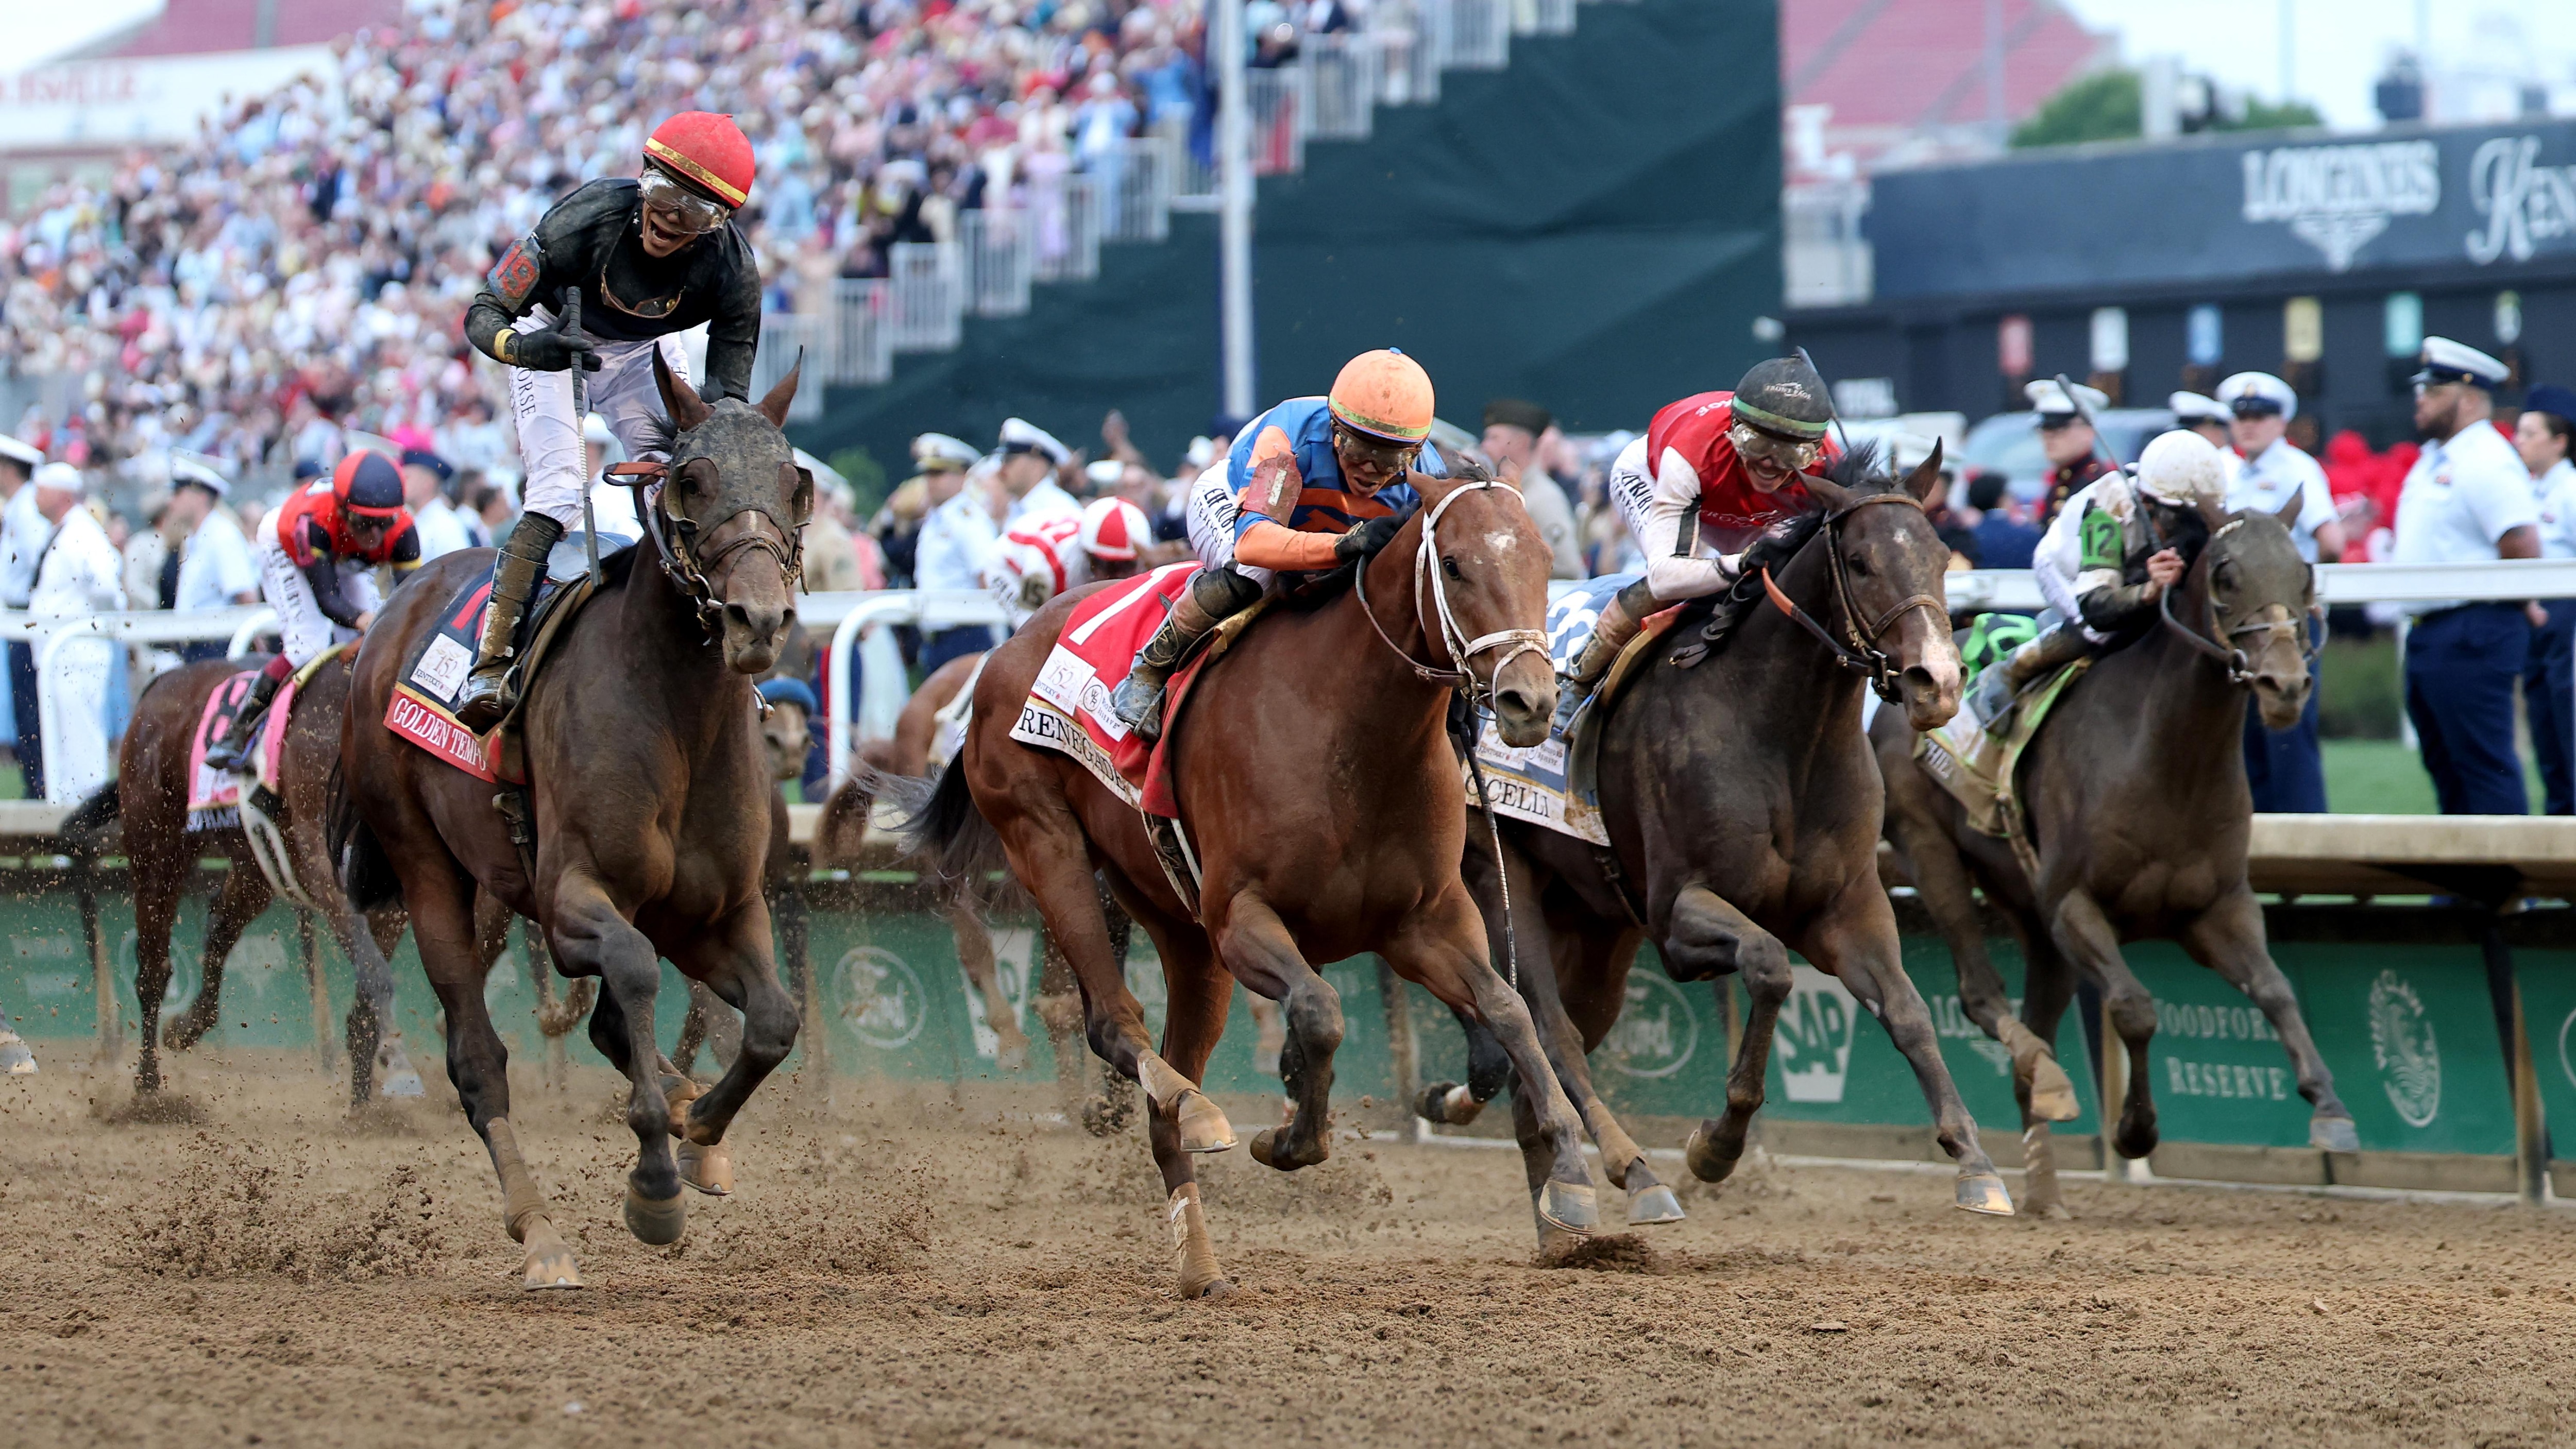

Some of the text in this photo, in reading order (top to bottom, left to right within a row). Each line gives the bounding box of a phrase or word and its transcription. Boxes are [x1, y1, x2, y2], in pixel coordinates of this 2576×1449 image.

[2242, 139, 2441, 223] LONGINES
[496, 244, 536, 299] 19
[516, 366, 536, 419] ORSE
[1267, 467, 1287, 507] 1
[2087, 523, 2115, 558] 12
[1022, 577, 1047, 607] 15
[1068, 562, 1199, 646] 1
[433, 655, 458, 679] 152
[1047, 664, 1074, 690] 152
[393, 697, 452, 749] GOLDEN
[1019, 707, 1126, 792] RENEGADE
[1465, 774, 1550, 818] OCELLI
[1776, 990, 1848, 1075] SAP
[2165, 1056, 2287, 1101] RESERVE
